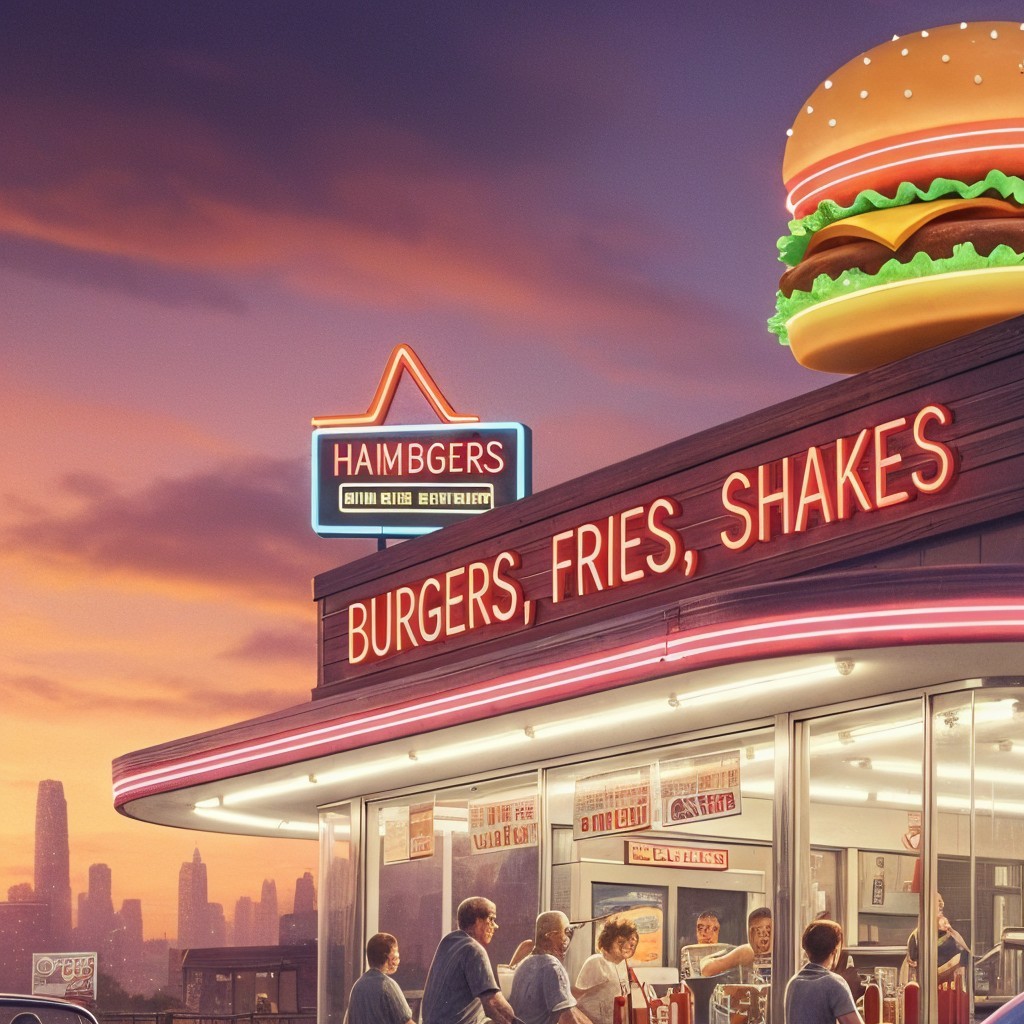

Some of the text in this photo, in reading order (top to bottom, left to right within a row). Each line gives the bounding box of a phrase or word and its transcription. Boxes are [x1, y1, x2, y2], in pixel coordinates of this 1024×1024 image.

[347, 403, 956, 665] BURGERS, FRIES, SHAKES
